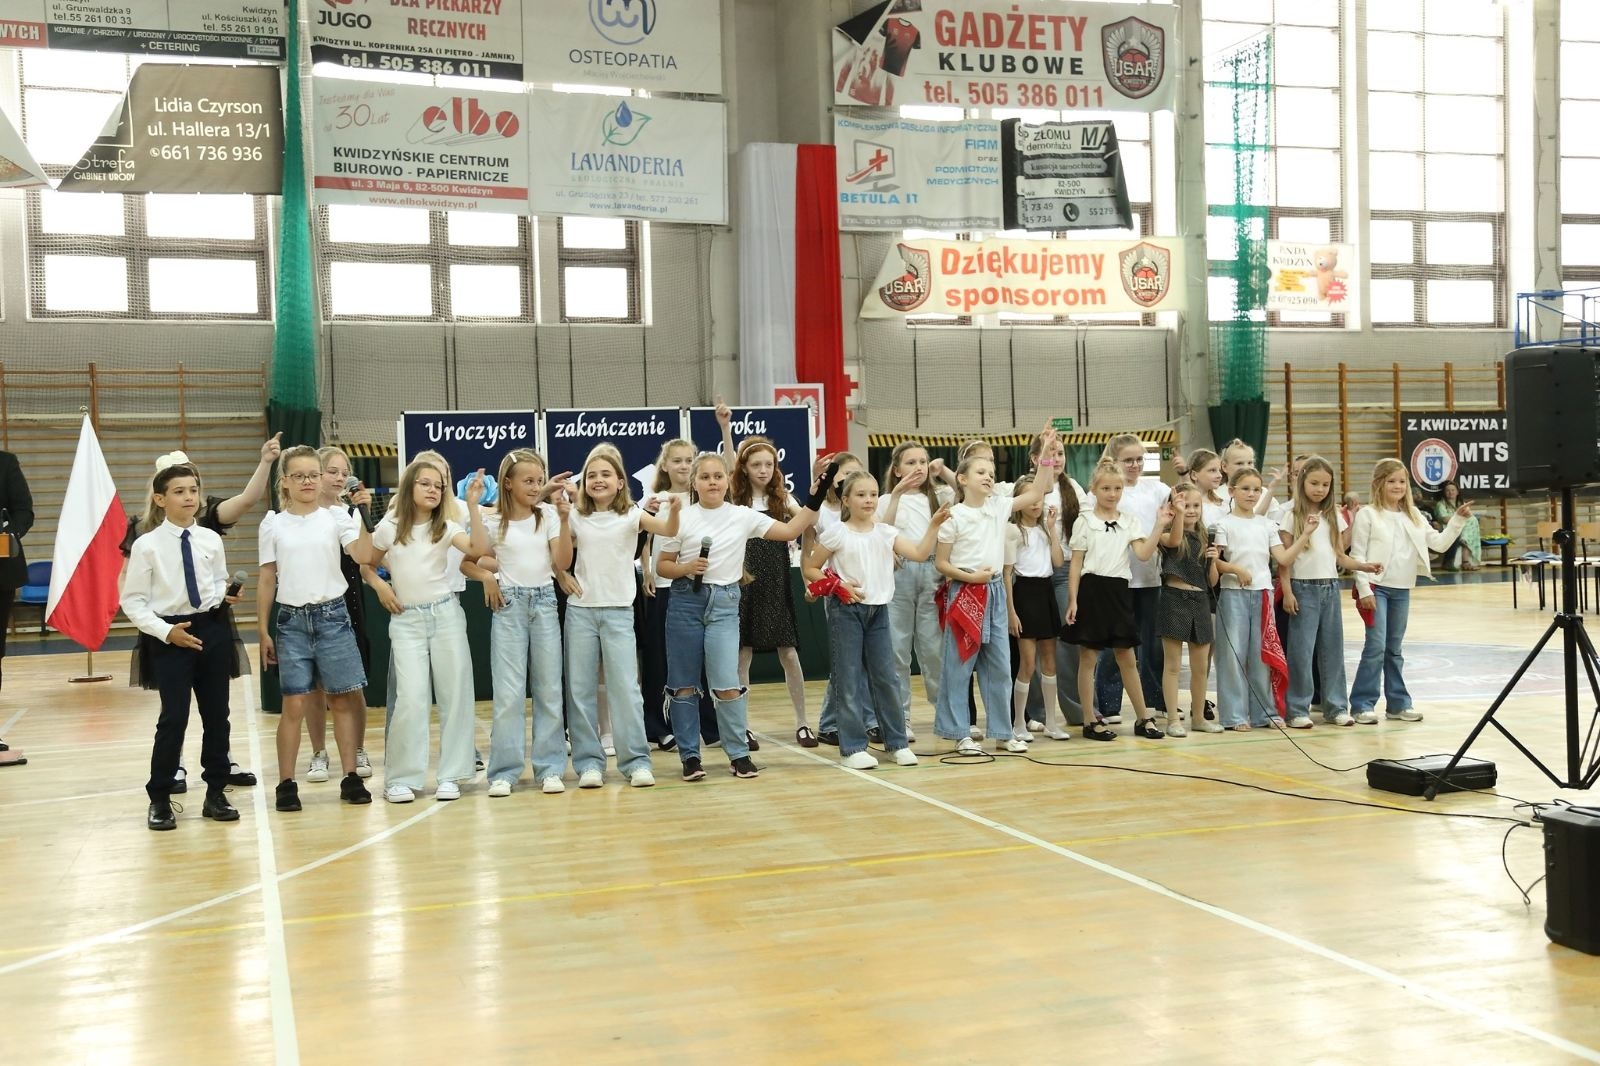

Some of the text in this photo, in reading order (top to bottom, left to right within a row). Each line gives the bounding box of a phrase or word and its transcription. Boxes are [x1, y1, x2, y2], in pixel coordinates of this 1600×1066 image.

[66, 4, 124, 14] Grunwaldzka
[243, 6, 278, 17] Kwidzyn
[85, 15, 101, 23] 261
[105, 16, 117, 24] 00
[121, 17, 132, 25] 33
[215, 14, 260, 23] Kościuszki
[317, 10, 372, 29] JUGO
[54, 26, 86, 35] KOMUNIE
[93, 28, 126, 37] CHRZCINY
[133, 31, 166, 40] URODZINY
[203, 23, 279, 35] tel. 55 261 91 91
[408, 17, 486, 40] RĘCZNYCH
[934, 5, 1089, 52] GADŻETY
[149, 41, 200, 52] CETERING
[313, 35, 350, 46] KWIDZYN
[369, 42, 416, 52] KOPERNIKA
[418, 46, 433, 54] 25A
[445, 48, 473, 57] PIĘTRO
[481, 52, 515, 61] JAMNIK)
[342, 53, 491, 78] tel. 505 386 011
[569, 49, 677, 70] OSTEOPATIA
[939, 52, 1084, 75] KLUBOWE
[1114, 58, 1155, 77] USAR
[924, 80, 1103, 108] tel. 505 386 011
[154, 98, 262, 117] Lidia Czyrson
[335, 104, 371, 129] 30
[423, 97, 519, 138] elbo
[837, 119, 998, 134] KOMPLEKSOWA OBSŁUGA INFORMATYCZNA
[147, 123, 270, 139] ul. Hallera 13/1
[1034, 129, 1071, 141] ZŁOMU
[161, 146, 262, 161] 661 736 936
[965, 138, 998, 151] FIRM
[75, 149, 135, 172] Strefa
[333, 147, 509, 168] KWIDZYŃSKIE CENTRUM
[571, 152, 684, 177] LAVANDERIA
[73, 172, 135, 181] GABINET URODY
[334, 162, 403, 176] BIUROWO
[417, 168, 509, 182] PAPIERNICZE
[351, 180, 364, 188] ul.
[376, 181, 400, 191] Maja
[415, 183, 449, 192] 82-500
[452, 185, 493, 195] Kwidzyn
[926, 178, 999, 186] MEDYCZNYCH
[369, 197, 477, 209] www.elbokwidzyn.pl
[840, 192, 918, 204] BETULA IT
[589, 202, 668, 213] www.lavanderia.pl
[941, 246, 1105, 280] Dziękujemy
[885, 278, 925, 295] USAR
[1130, 274, 1164, 291] USAR
[945, 285, 1107, 312] sponsorom
[555, 412, 666, 438] zakończenie
[729, 411, 767, 435] roku
[1407, 419, 1418, 431] Z
[1421, 418, 1499, 431] KWIDZYNA
[425, 420, 527, 450] Uroczyste
[1458, 442, 1509, 462] MTS
[1460, 474, 1490, 489] NIE
